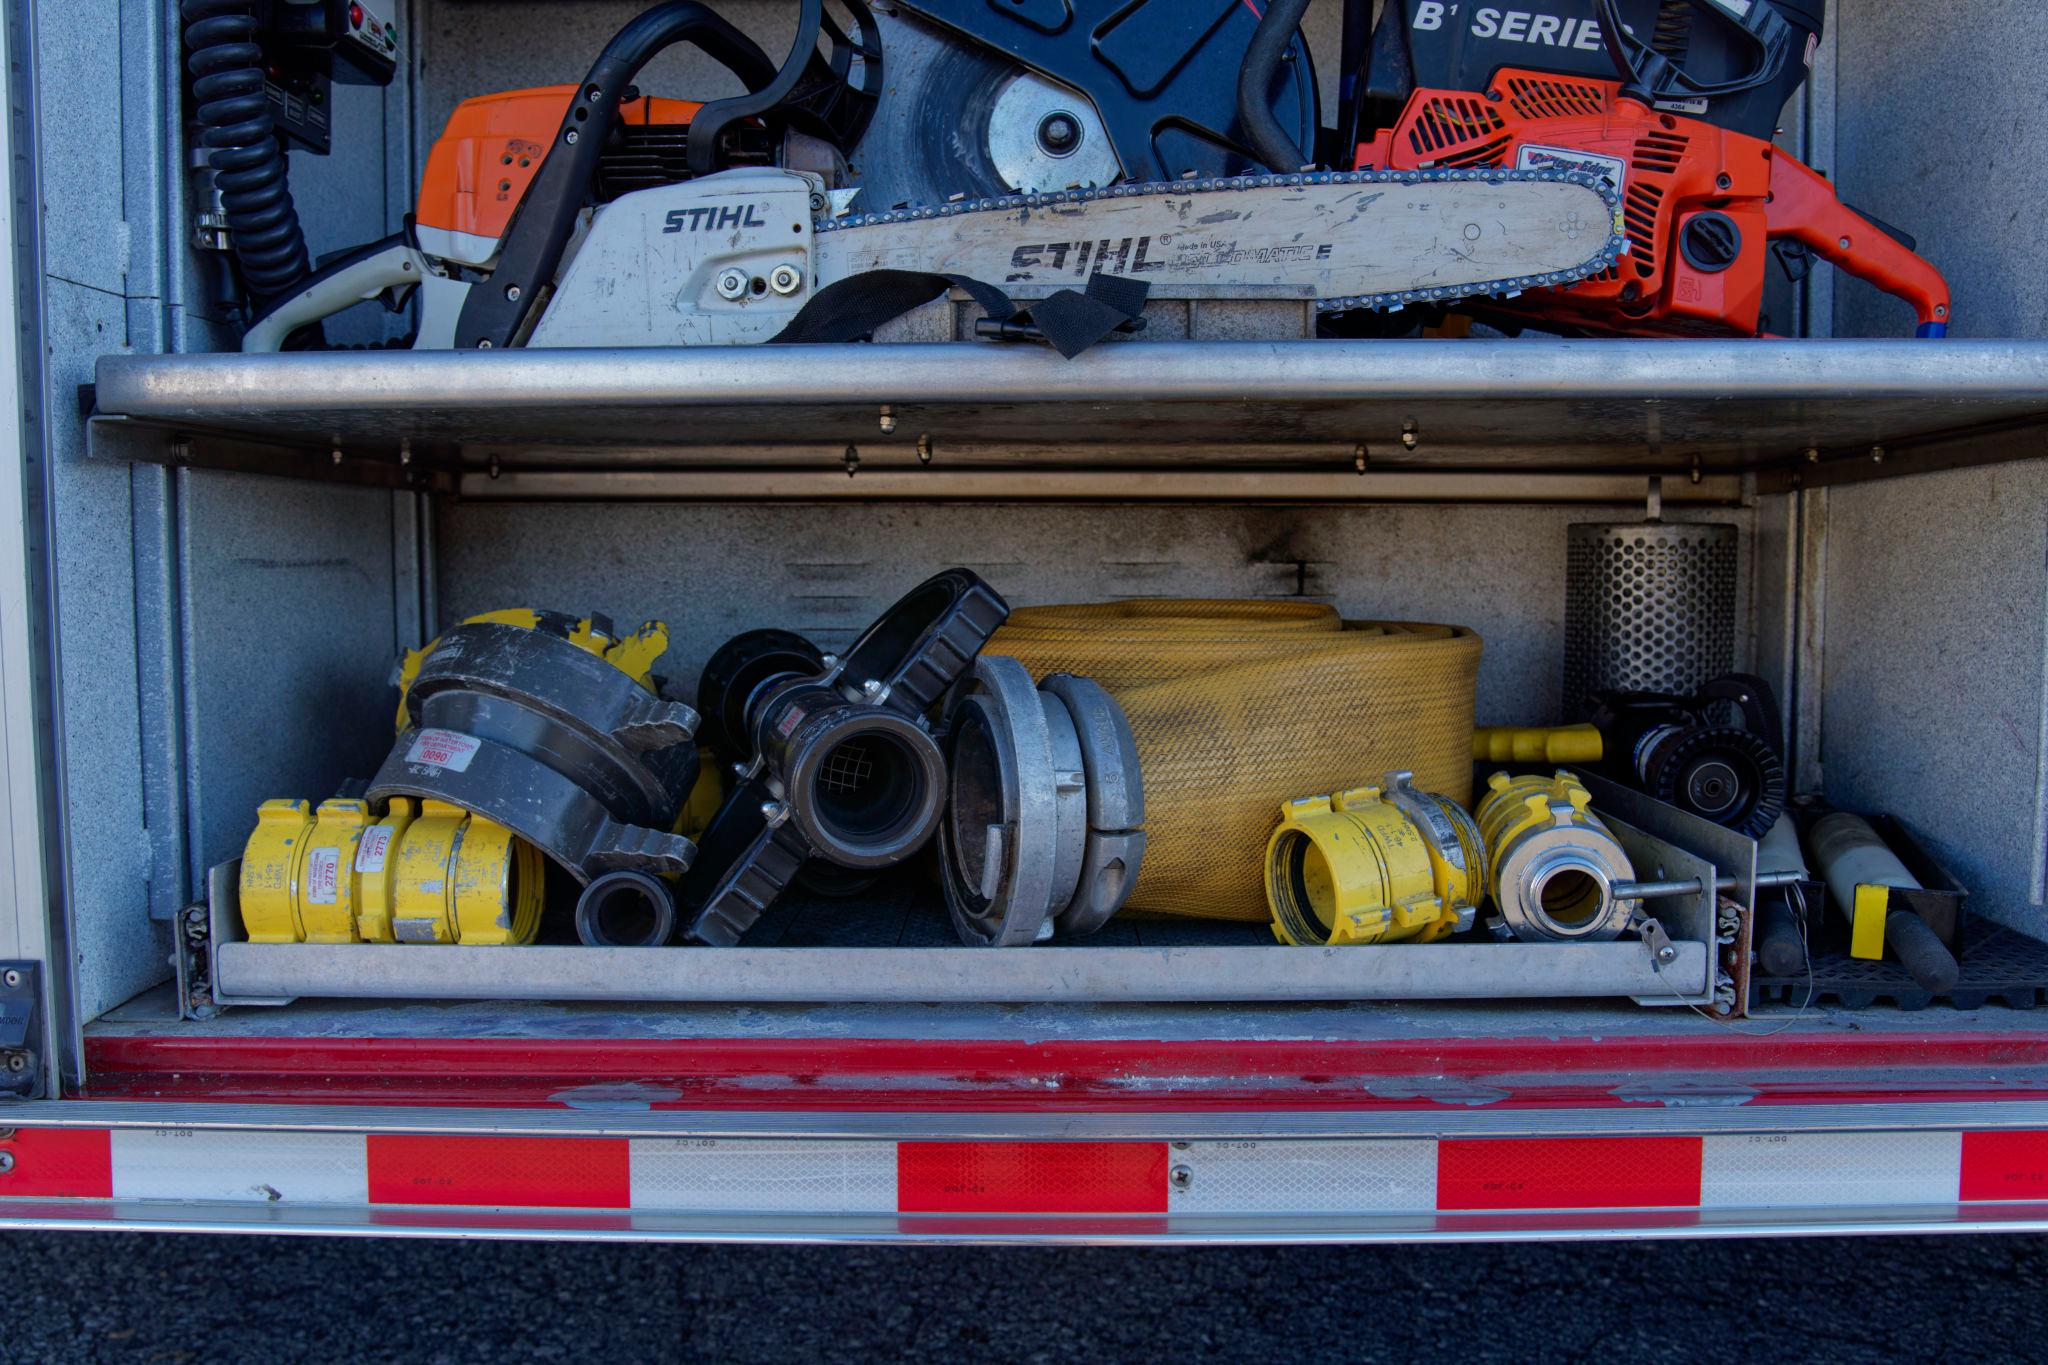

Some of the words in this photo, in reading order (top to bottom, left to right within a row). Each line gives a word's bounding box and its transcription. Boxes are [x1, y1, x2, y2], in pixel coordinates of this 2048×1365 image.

[1578, 160, 1614, 177] Edge
[662, 204, 766, 234] STIHL
[1201, 241, 1208, 249] in
[1210, 240, 1227, 249] USA
[1005, 236, 1166, 282] STIHL
[422, 750, 447, 762] 0090
[325, 863, 335, 886] 2770
